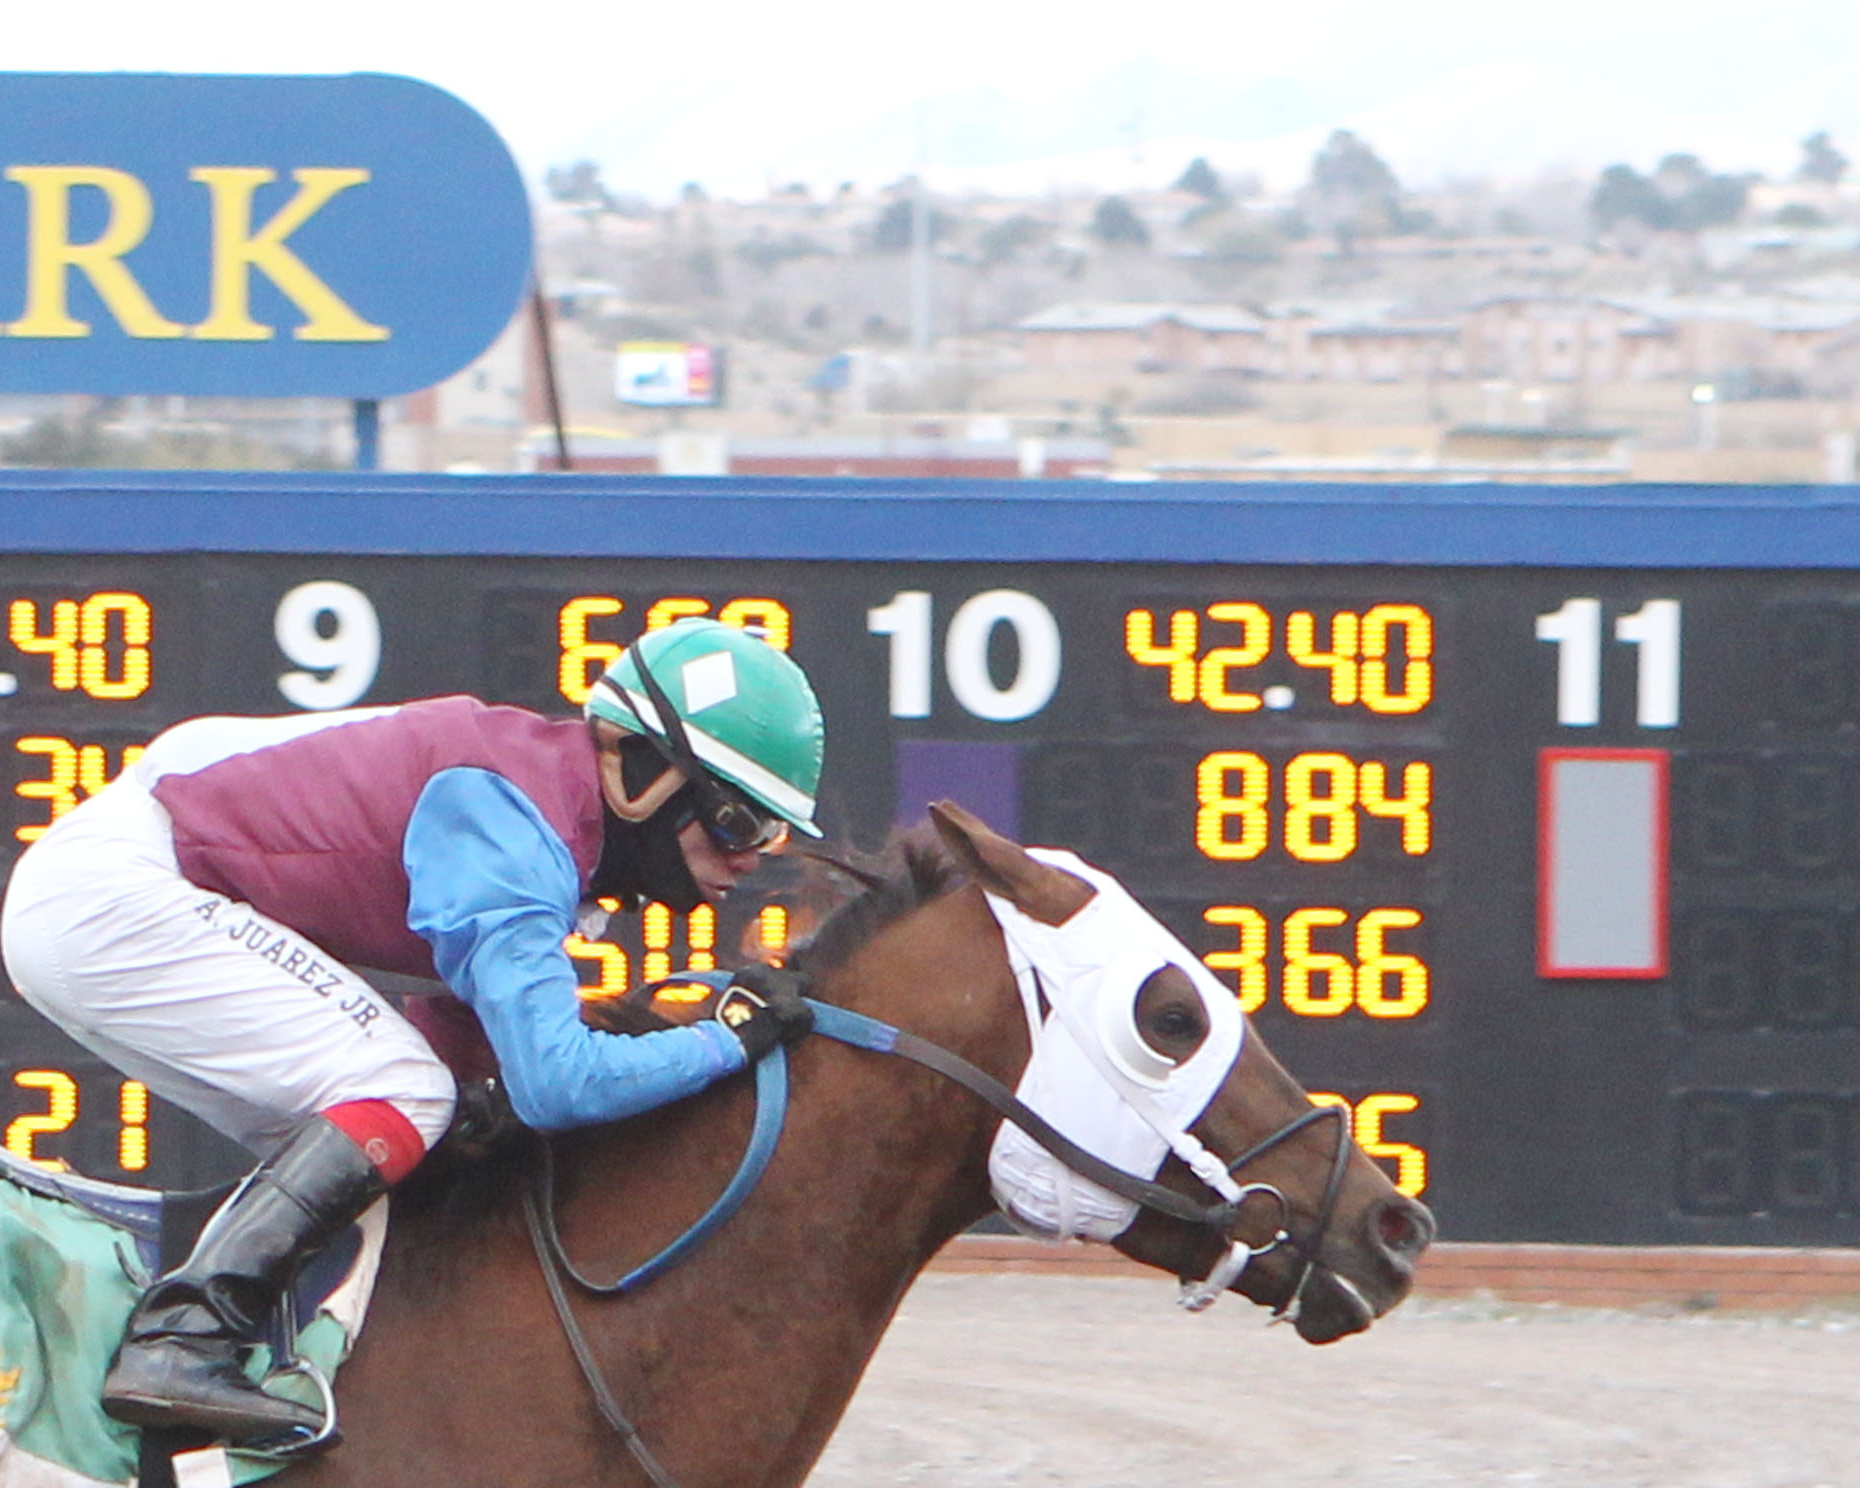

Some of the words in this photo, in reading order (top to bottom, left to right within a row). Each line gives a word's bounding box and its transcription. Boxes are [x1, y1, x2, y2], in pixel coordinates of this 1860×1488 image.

[274, 580, 382, 709] 9
[867, 589, 1062, 721] 10
[1125, 601, 1433, 714] 42.40
[1535, 598, 1681, 728] 11
[193, 898, 222, 928] A.
[228, 918, 344, 999] JUAREZ
[339, 994, 381, 1039] JR.
